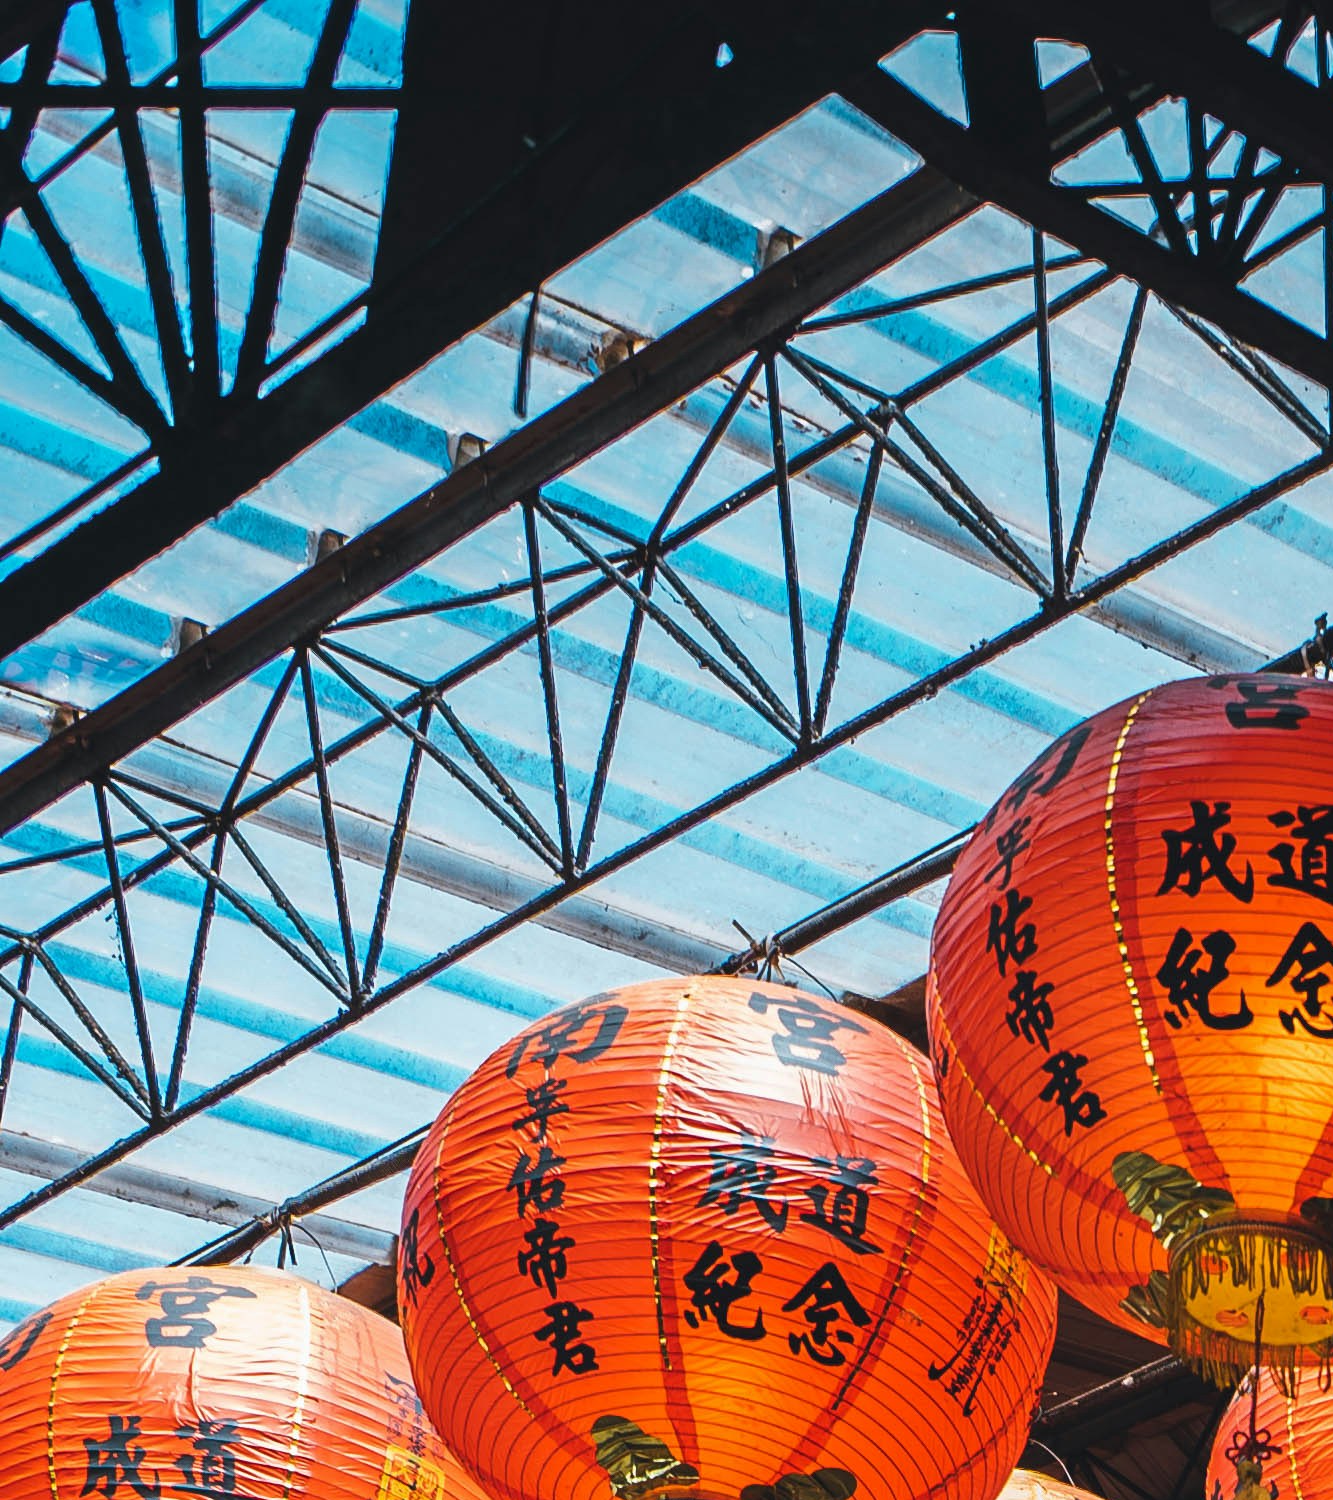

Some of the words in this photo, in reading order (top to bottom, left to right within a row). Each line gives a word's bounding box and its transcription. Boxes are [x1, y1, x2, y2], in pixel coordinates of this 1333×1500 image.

[985, 811, 1107, 1134] 孚佑帝君
[506, 1078, 599, 1377] 孚佑帝君
[681, 1241, 870, 1367] 紀念
